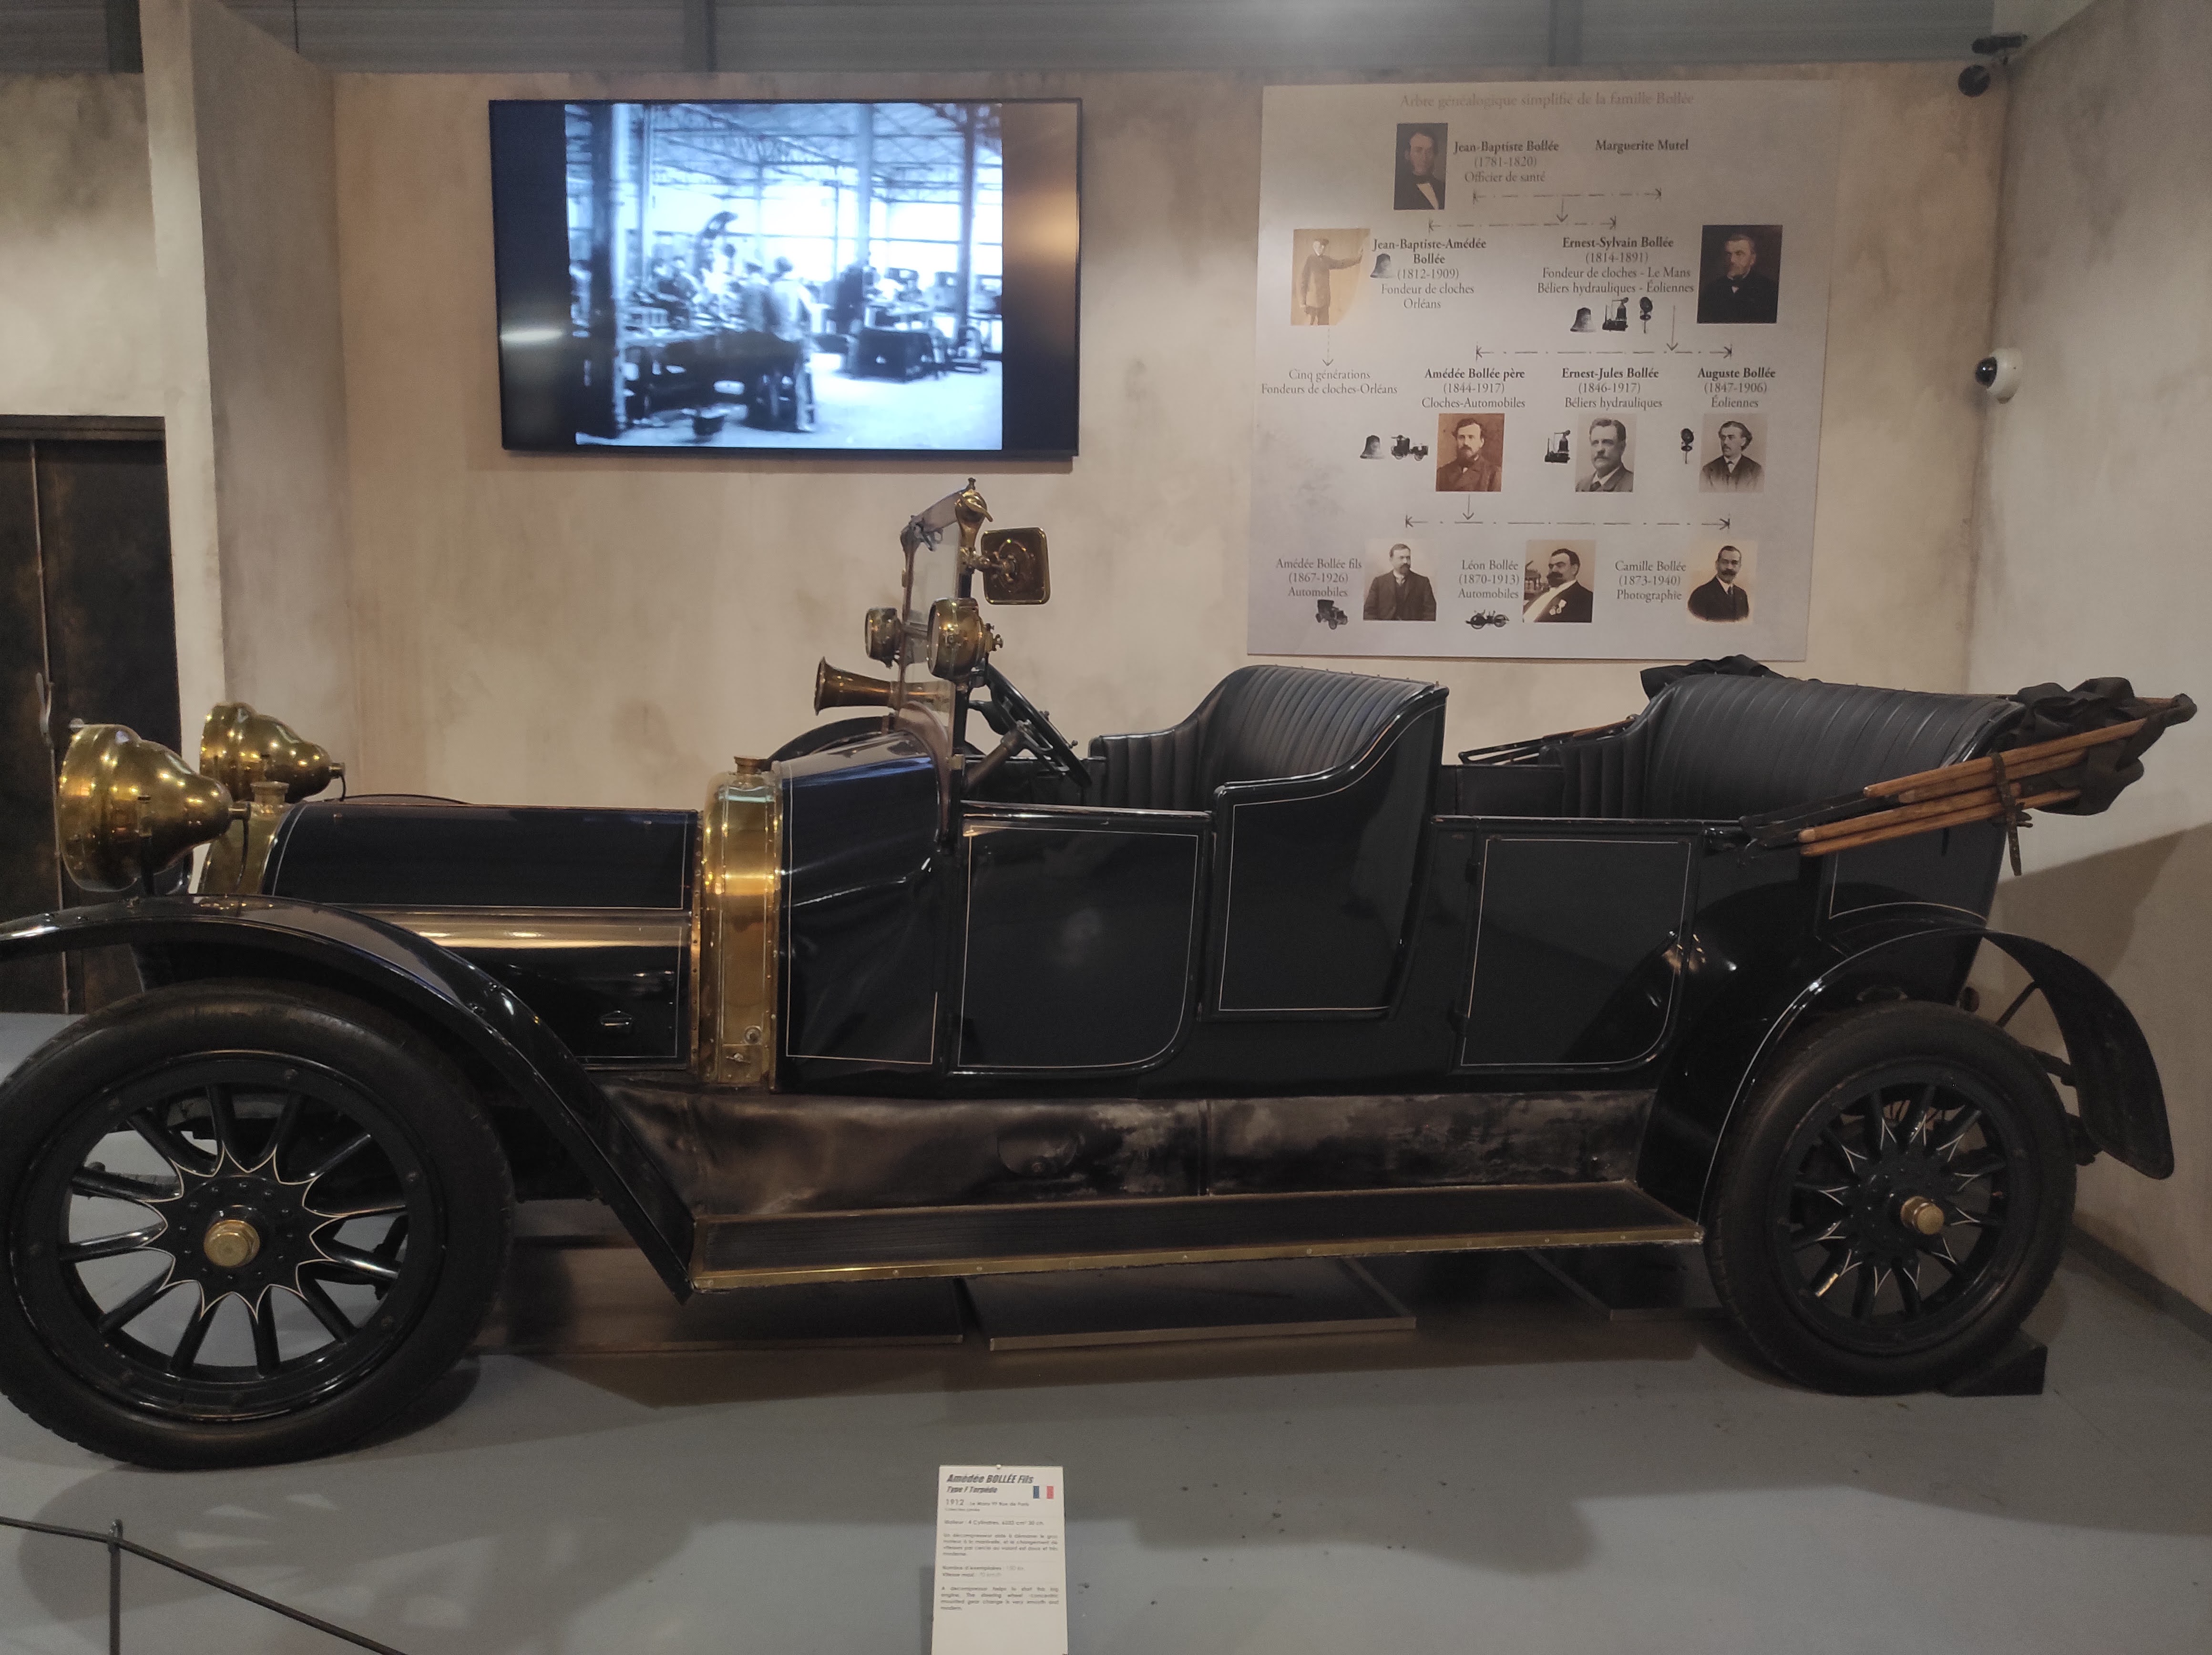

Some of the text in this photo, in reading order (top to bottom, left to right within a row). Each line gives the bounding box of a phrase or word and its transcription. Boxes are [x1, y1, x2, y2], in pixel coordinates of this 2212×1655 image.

[1401, 94, 1434, 107] Arbre
[1577, 92, 1591, 104] de
[1596, 92, 1606, 104] la
[1610, 92, 1651, 104] famille
[1453, 140, 1559, 154] Jean-Baptiste Bollée
[1595, 139, 1689, 154] Marguerite Mutel
[1474, 156, 1536, 168] (1781-1820)
[1464, 171, 1545, 182] Officier de santé
[1372, 238, 1487, 252] Jean-Baptiste-Amédée
[1562, 235, 1674, 250] Ernest-Sylvain Bollée
[1413, 253, 1445, 264] Bollée
[1586, 252, 1648, 265] (1814-1891)
[1397, 268, 1459, 281] (1812-1909)
[1543, 267, 1584, 278] Fondeur
[1587, 266, 1598, 278] de
[1602, 266, 1637, 278] cloches
[1648, 267, 1659, 278] Le
[1663, 267, 1690, 278] Mans
[1382, 283, 1475, 294] Fondeur de cloches
[1537, 282, 1569, 294] Béliers
[1573, 281, 1636, 296] hydrauliques
[1647, 280, 1694, 294] Éoliennes
[1403, 297, 1441, 309] Orléans
[1289, 368, 1371, 382] Cinq générations
[1424, 368, 1525, 381] Amédée Bollée père
[1561, 367, 1659, 381] Ernest-Jules Bollée
[1697, 367, 1776, 381] Auguste Bollée
[1261, 383, 1305, 394] Fondeurs
[1308, 383, 1319, 394] de
[1443, 383, 1505, 395] (1844-1917)
[1578, 382, 1640, 395] (1846-1917)
[1704, 382, 1767, 394] (1847-1906)
[1422, 397, 1526, 408] Cloches-Automobiles
[1565, 396, 1662, 411] Béliers hydrauliques
[1711, 395, 1759, 408] Éoliennes
[1276, 557, 1362, 569] Amédée Bollée fils
[1462, 559, 1519, 570] Léon Bollée
[1615, 560, 1687, 572] Camille Bollée
[1289, 572, 1348, 584] (1867-1926)
[1459, 573, 1520, 585] (1870-1913)
[1618, 575, 1681, 587] (1873-1940)
[1288, 586, 1348, 597] Automobiles
[1458, 588, 1519, 599] Automobiles
[1617, 589, 1682, 603] Photographie
[946, 1474, 984, 1483] Amédée
[986, 1474, 1017, 1483] BOLLÉE
